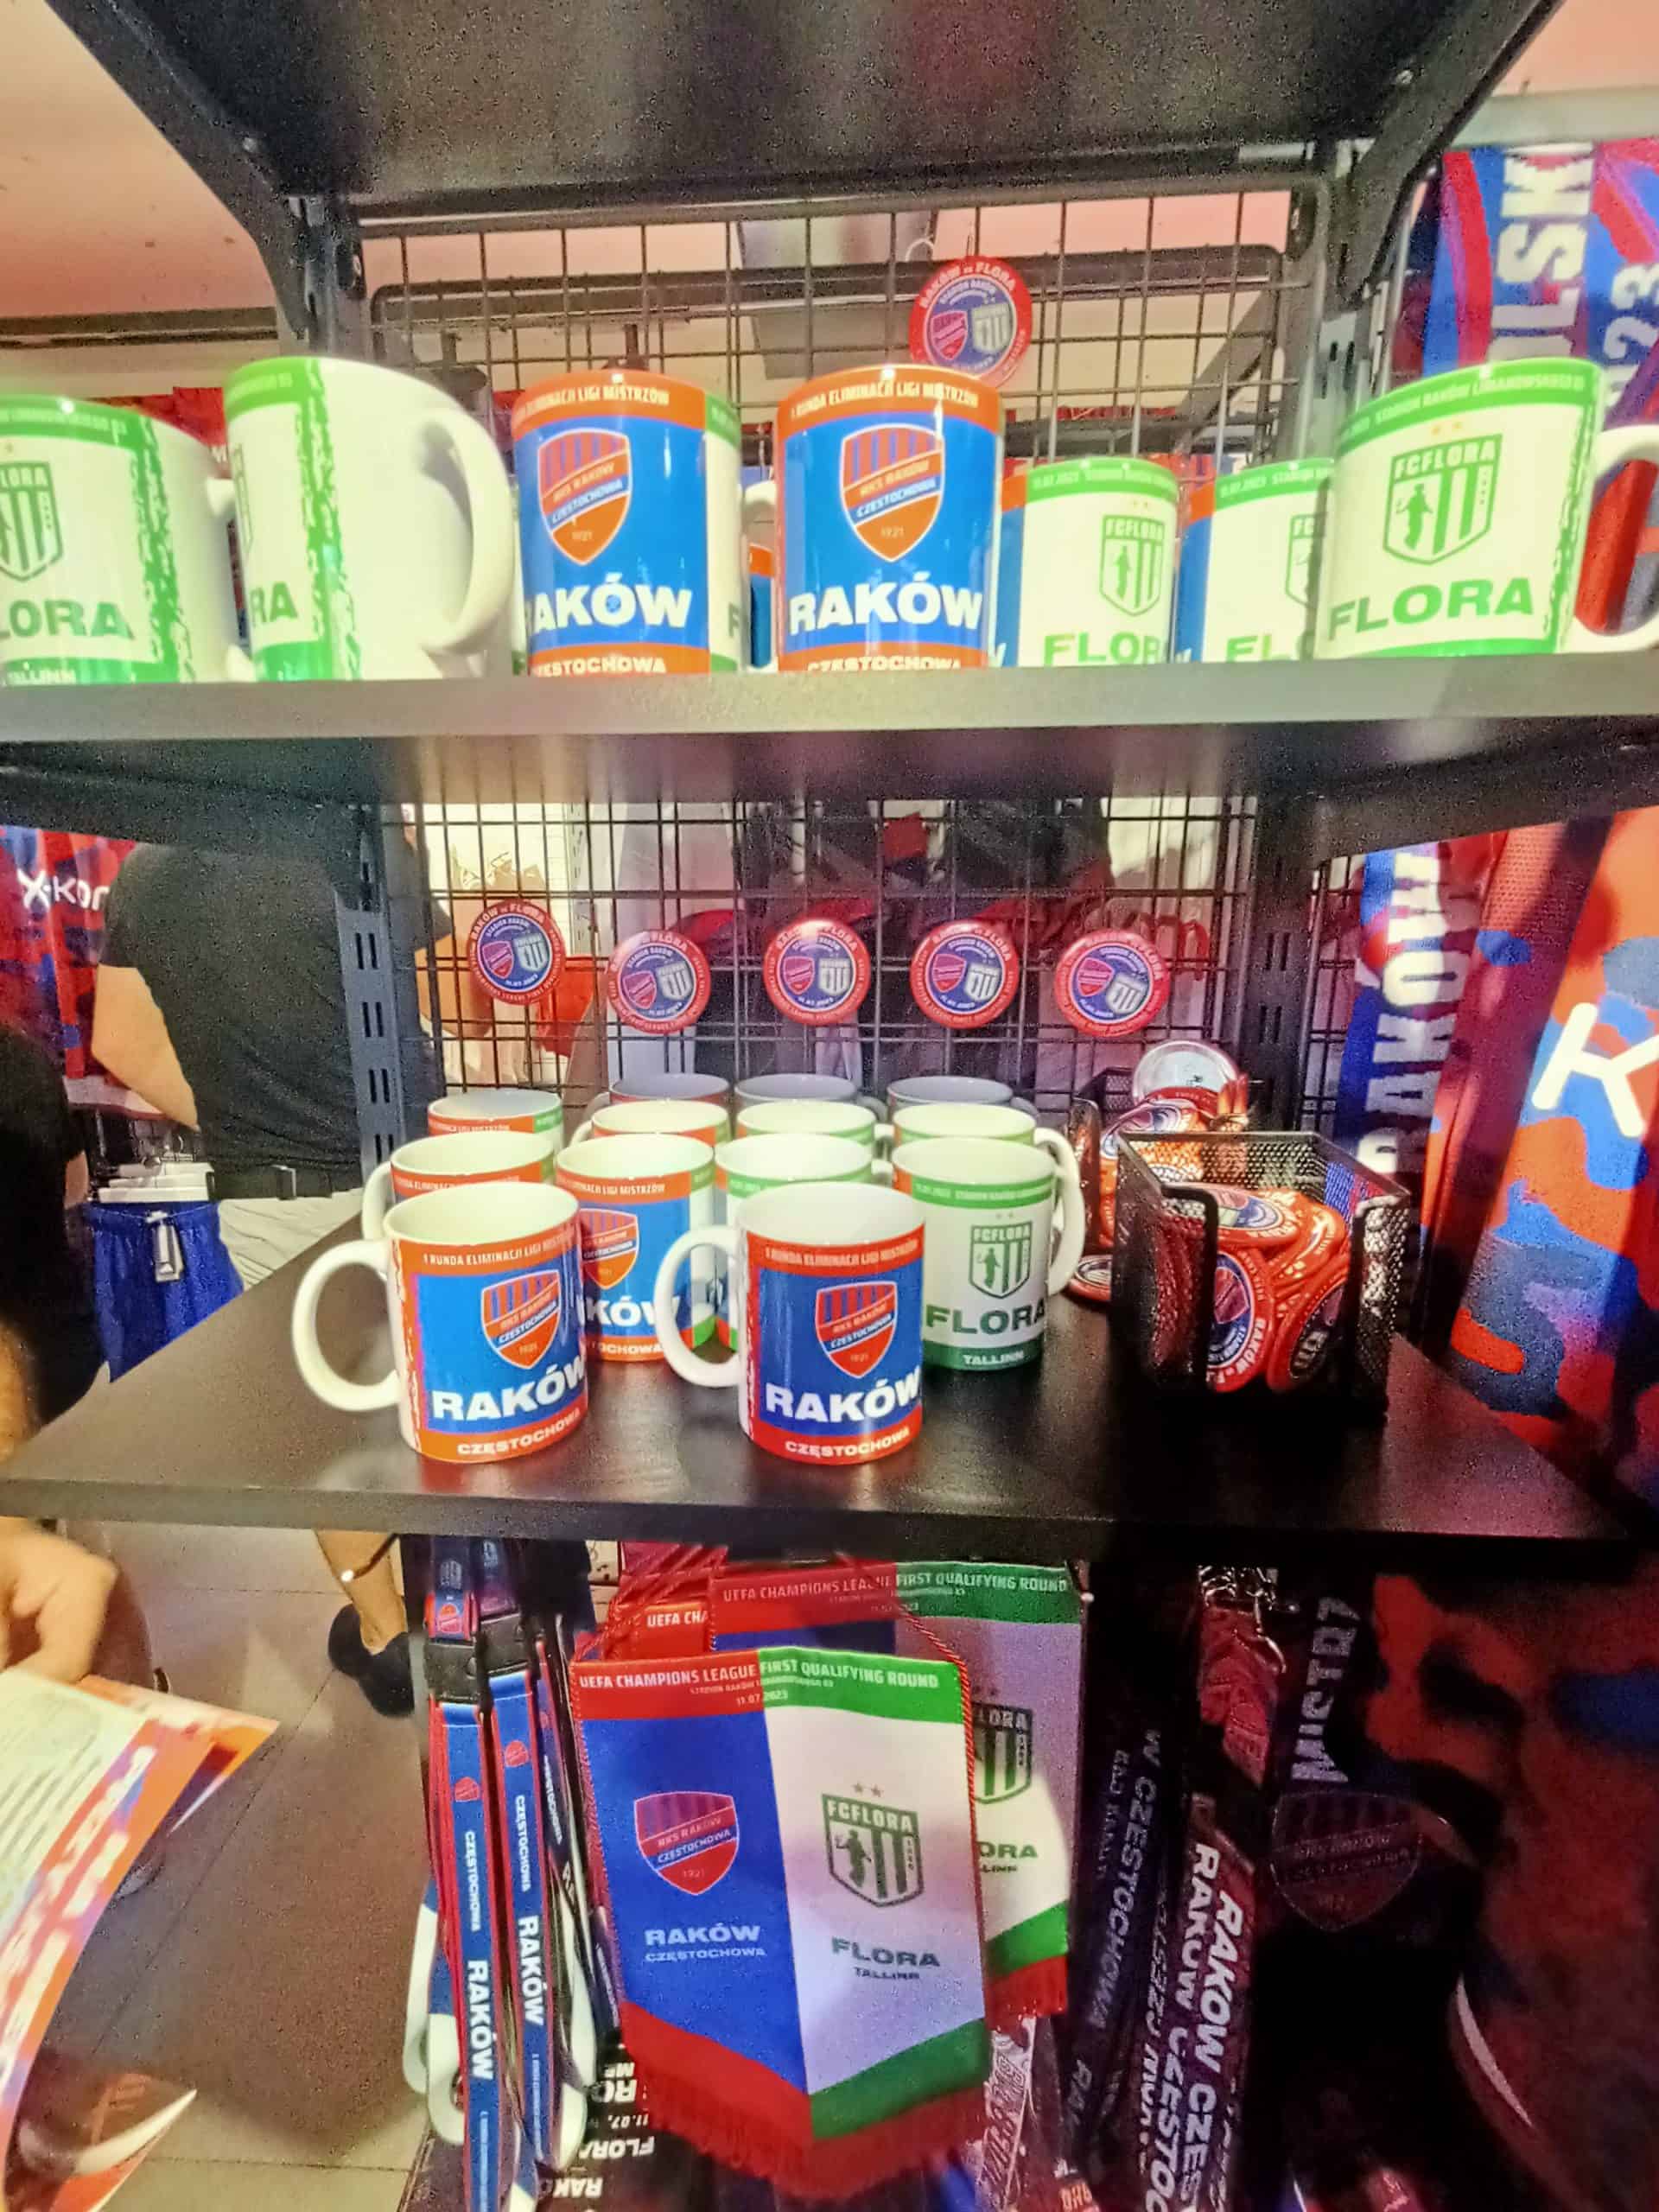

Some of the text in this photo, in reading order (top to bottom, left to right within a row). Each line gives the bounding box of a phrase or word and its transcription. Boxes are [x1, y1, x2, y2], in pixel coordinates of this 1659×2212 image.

[789, 571, 983, 635] RAKÓW
[1329, 578, 1533, 643] FLORA
[466, 1249, 523, 1266] ELIMINACJI
[925, 1297, 1046, 1335] FLORA
[432, 1357, 586, 1421] RAKÓW
[765, 1364, 920, 1423] RAKÓW
[785, 1427, 910, 1459] CZĘSTOCHOWA
[722, 1587, 756, 1603] UEFA
[760, 1581, 838, 1601] CHAMPIONS
[896, 1572, 932, 1587] FIRST
[935, 1573, 1017, 1591] QUALIFYING
[1020, 1576, 1068, 1593] ROUND
[646, 1612, 680, 1628] UEFA
[579, 1658, 939, 1689] UEFA CHAMPIONS LEAGUE FIRST QUALIFYING ROUND
[645, 1921, 761, 1947] RAKÓW
[830, 1936, 941, 1967] FLORA
[518, 1914, 548, 2026] RAKÓW
[854, 1966, 920, 1980] TALLINN
[467, 1960, 498, 2081] RAKÓW
